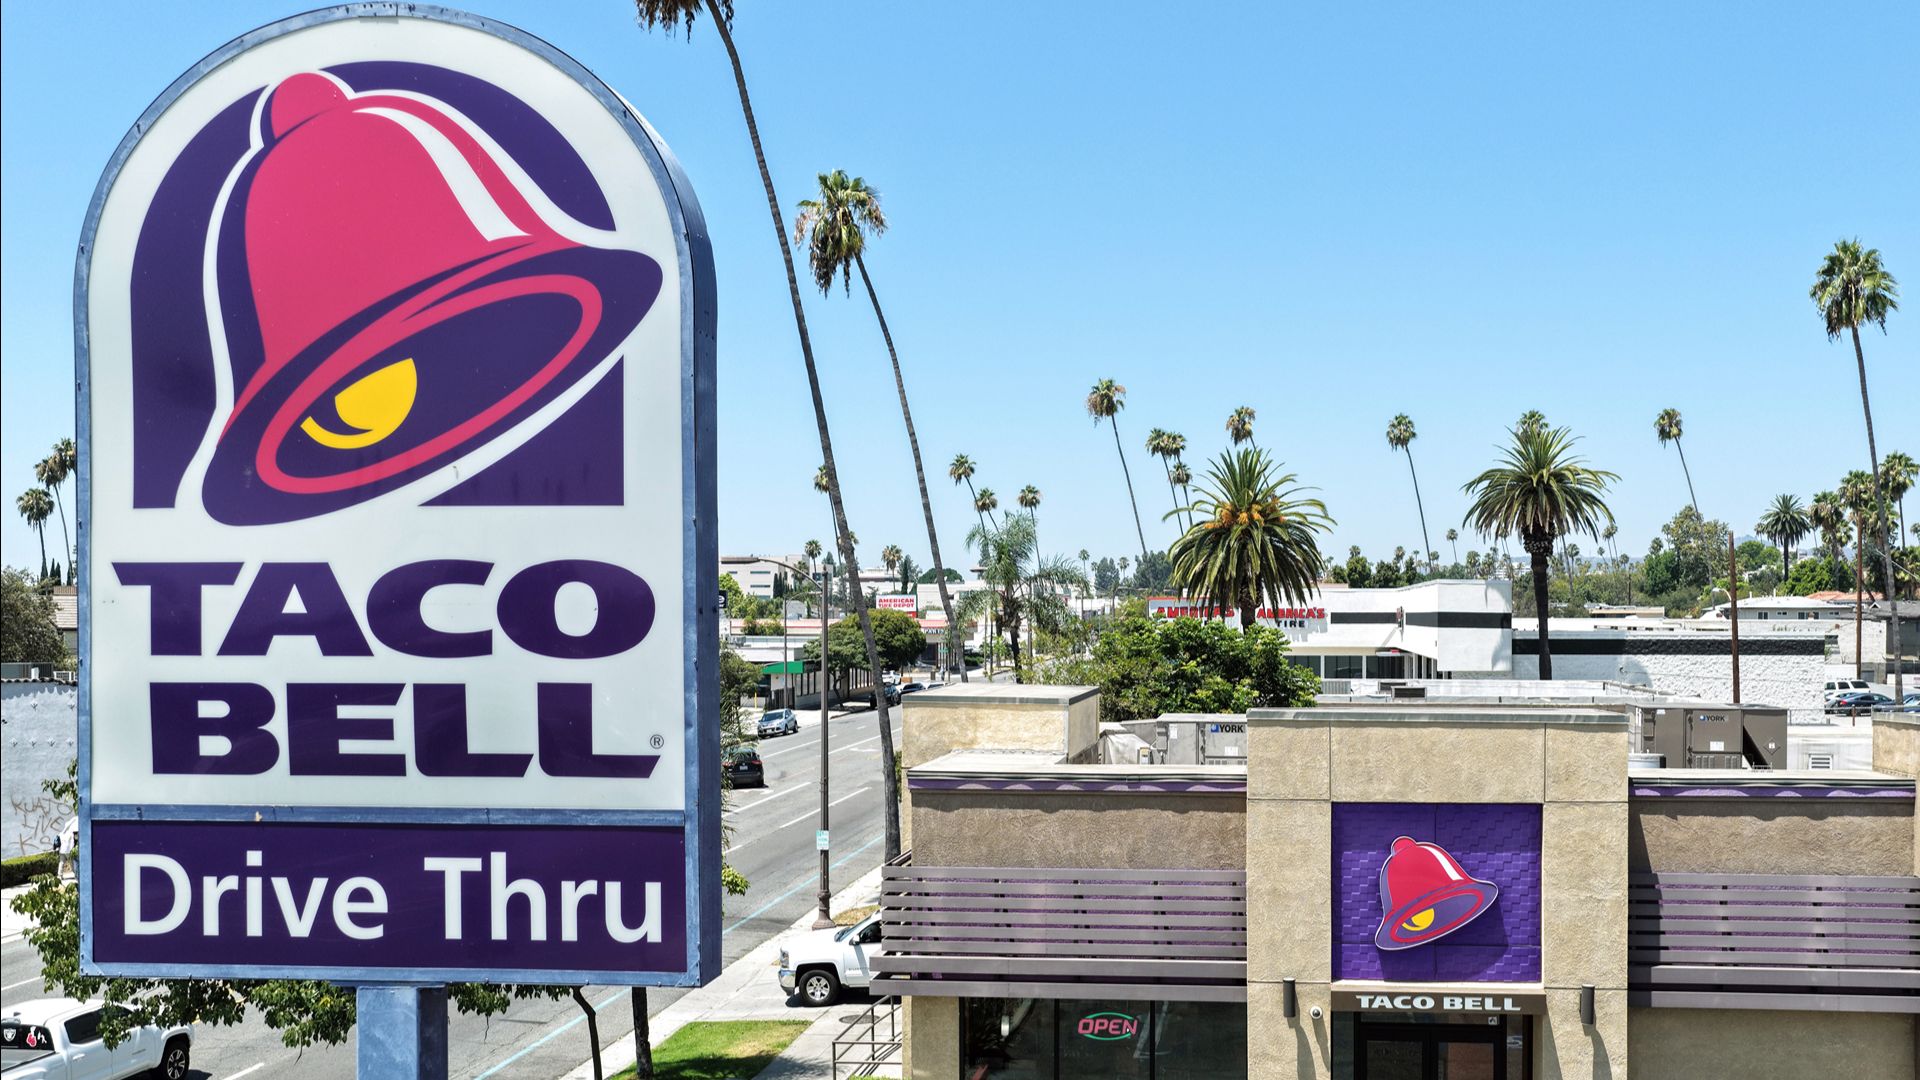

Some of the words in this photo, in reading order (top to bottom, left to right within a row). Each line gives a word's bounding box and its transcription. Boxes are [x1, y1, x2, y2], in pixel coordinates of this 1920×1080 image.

[112, 559, 656, 660] TACO
[1277, 620, 1305, 628] TIRE
[1705, 714, 1725, 722] YORK
[150, 682, 661, 779] BELL
[1219, 724, 1244, 733] YORK
[124, 850, 389, 940] Drive
[423, 851, 662, 944] Thru
[1356, 995, 1435, 1010] TACO
[1443, 996, 1521, 1011] BELL
[1078, 1018, 1138, 1035] OPEN
